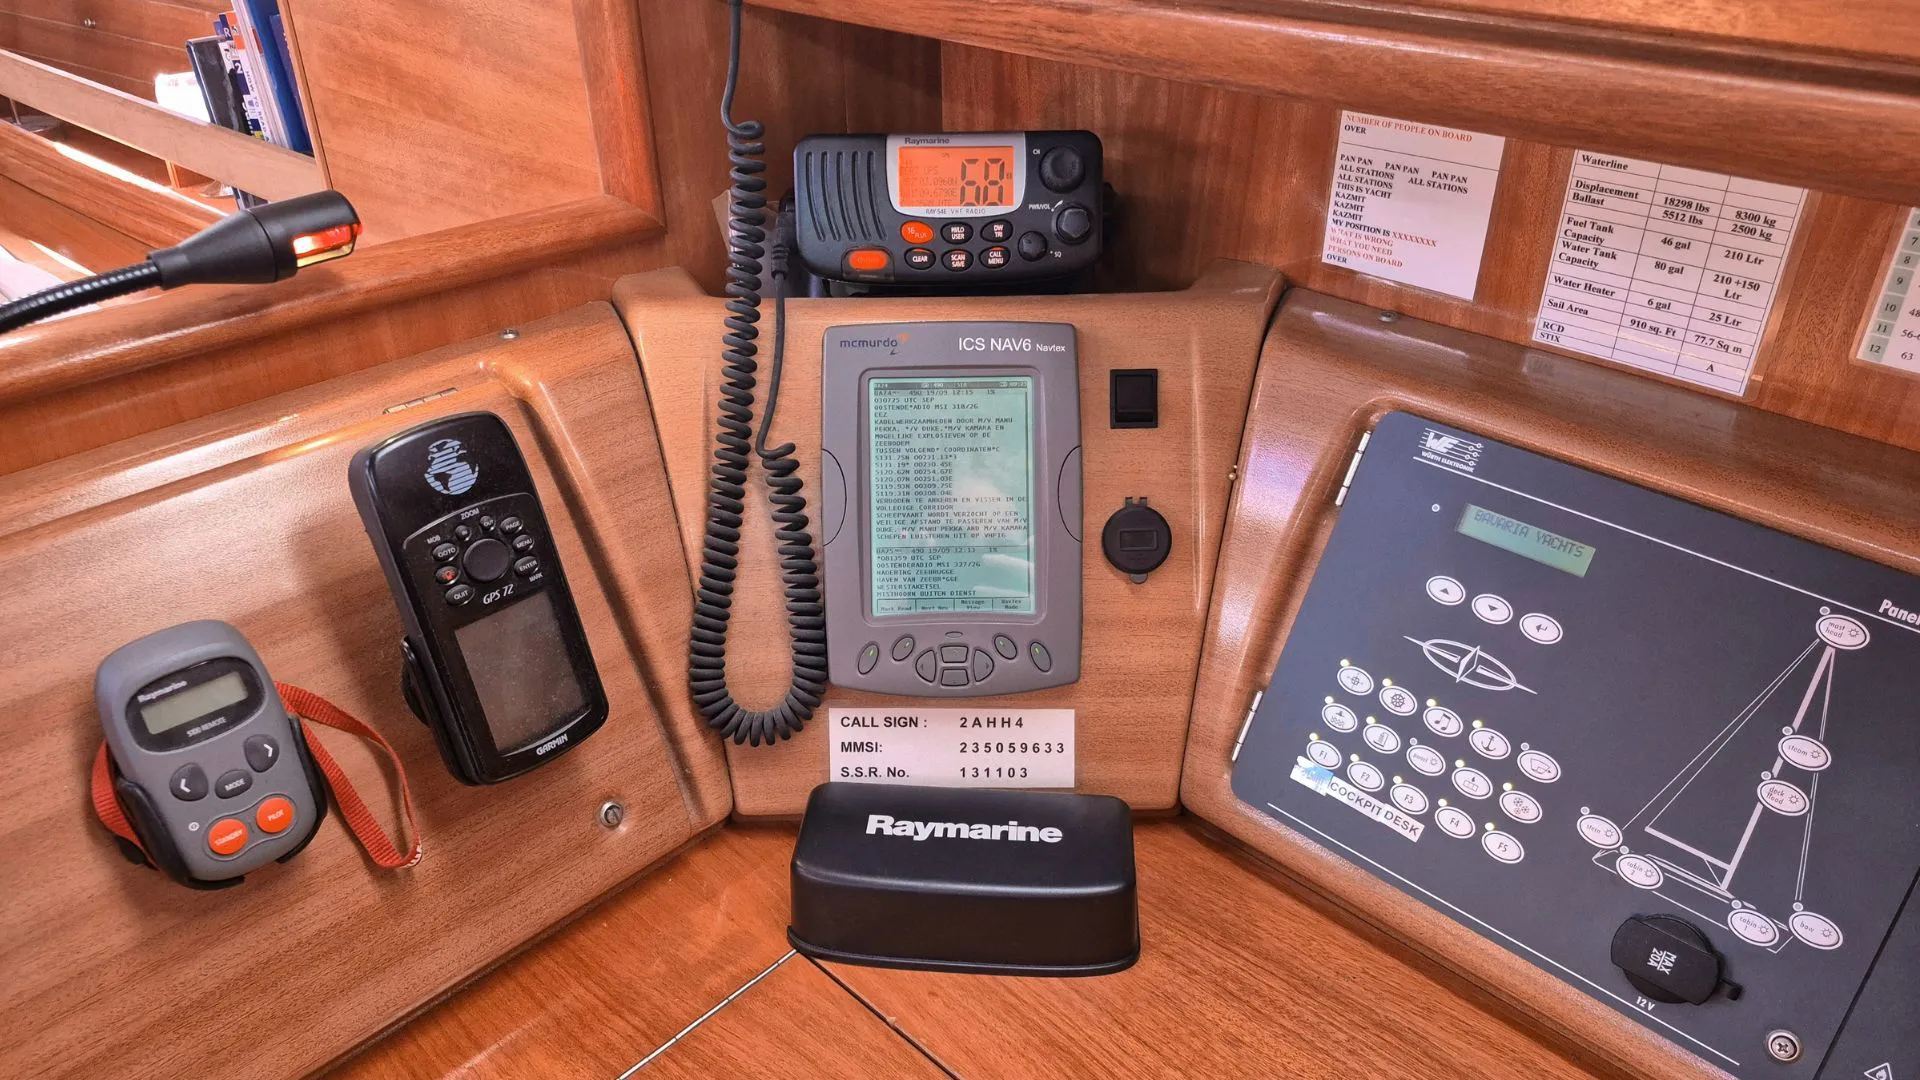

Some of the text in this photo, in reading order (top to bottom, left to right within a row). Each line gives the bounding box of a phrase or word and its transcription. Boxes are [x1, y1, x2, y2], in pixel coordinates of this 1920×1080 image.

[1344, 124, 1366, 134] OVER
[1346, 114, 1472, 142] NUMBER OF PEOPLE ON BOARD
[905, 137, 950, 146] Raymarine
[1340, 154, 1468, 184] PAN PAN PAN PAN PAN PAN
[1582, 154, 1628, 171] Waterline
[960, 158, 1005, 206] 68
[1337, 173, 1393, 189] ALL STATIONS
[1338, 164, 1468, 194] ALL STATIONS ALL STATIONS
[1335, 191, 1366, 203] KAZMIT
[1336, 182, 1392, 199] THIS YACHT
[1334, 200, 1364, 212] KAZMIT
[1575, 180, 1777, 228] Displacement 18298 lbs 8300 kg
[1332, 209, 1363, 222] KAZMIT
[1572, 192, 1773, 242] Ballast 5512 lbs 2500 kg
[1332, 218, 1381, 235] MY POSITION
[1364, 234, 1393, 247] WRONG
[1564, 228, 1605, 245] Capacity
[1566, 216, 1765, 266] Fuel Tank 46 gal 210 Ltr
[1354, 240, 1392, 255] YOU NEED
[1326, 254, 1347, 264] OVER
[1328, 245, 1402, 267] PERSONS BOARD
[1561, 240, 1760, 292] Water Tank 80 gal 210 +150
[1558, 252, 1742, 301] Capacity Ltr
[1553, 275, 1742, 327] Water Heater 6 gal 25 Ltr
[1884, 303, 1896, 312] 10
[1547, 298, 1742, 354] Sail Area 910 sq. Ft 77.7 Sq m
[1876, 323, 1887, 333] 11
[840, 337, 1066, 352] mcmurdo ICS NAV6 Navtex
[1539, 332, 1561, 343] STIX
[1542, 321, 1715, 373] RCD A
[1868, 344, 1913, 360] 12 63
[1441, 457, 1475, 473] ELEKTRONIK
[460, 508, 480, 520] ZOOM
[505, 521, 520, 530] PAGE
[427, 535, 441, 544] MOB
[1474, 510, 1584, 558] BAVARIA YACHTS
[516, 538, 532, 549] MENU
[438, 547, 456, 558] GOTO
[519, 560, 537, 572] ENTER
[529, 572, 543, 582] MARK
[454, 591, 469, 600] QUIT
[483, 584, 514, 605] GPS 72
[137, 680, 188, 703] Raymarine
[840, 716, 879, 728] CALL
[884, 716, 919, 728] SIGN
[536, 733, 568, 756] GARMIN
[840, 742, 883, 753] MMSI:
[1318, 750, 1328, 760] F1
[840, 767, 882, 778] S.S.R.
[887, 767, 909, 778] No.
[1360, 772, 1369, 782] F2
[224, 778, 245, 792] MODE
[1403, 794, 1413, 804] F3
[1329, 782, 1418, 836] COCKPIT DESK
[866, 814, 1063, 843] Raymarine
[1449, 817, 1459, 828] F4
[214, 829, 243, 847] STANDBY
[1497, 842, 1507, 852] F5
[1647, 947, 1663, 968] 20A
[1660, 951, 1677, 975] MAX
